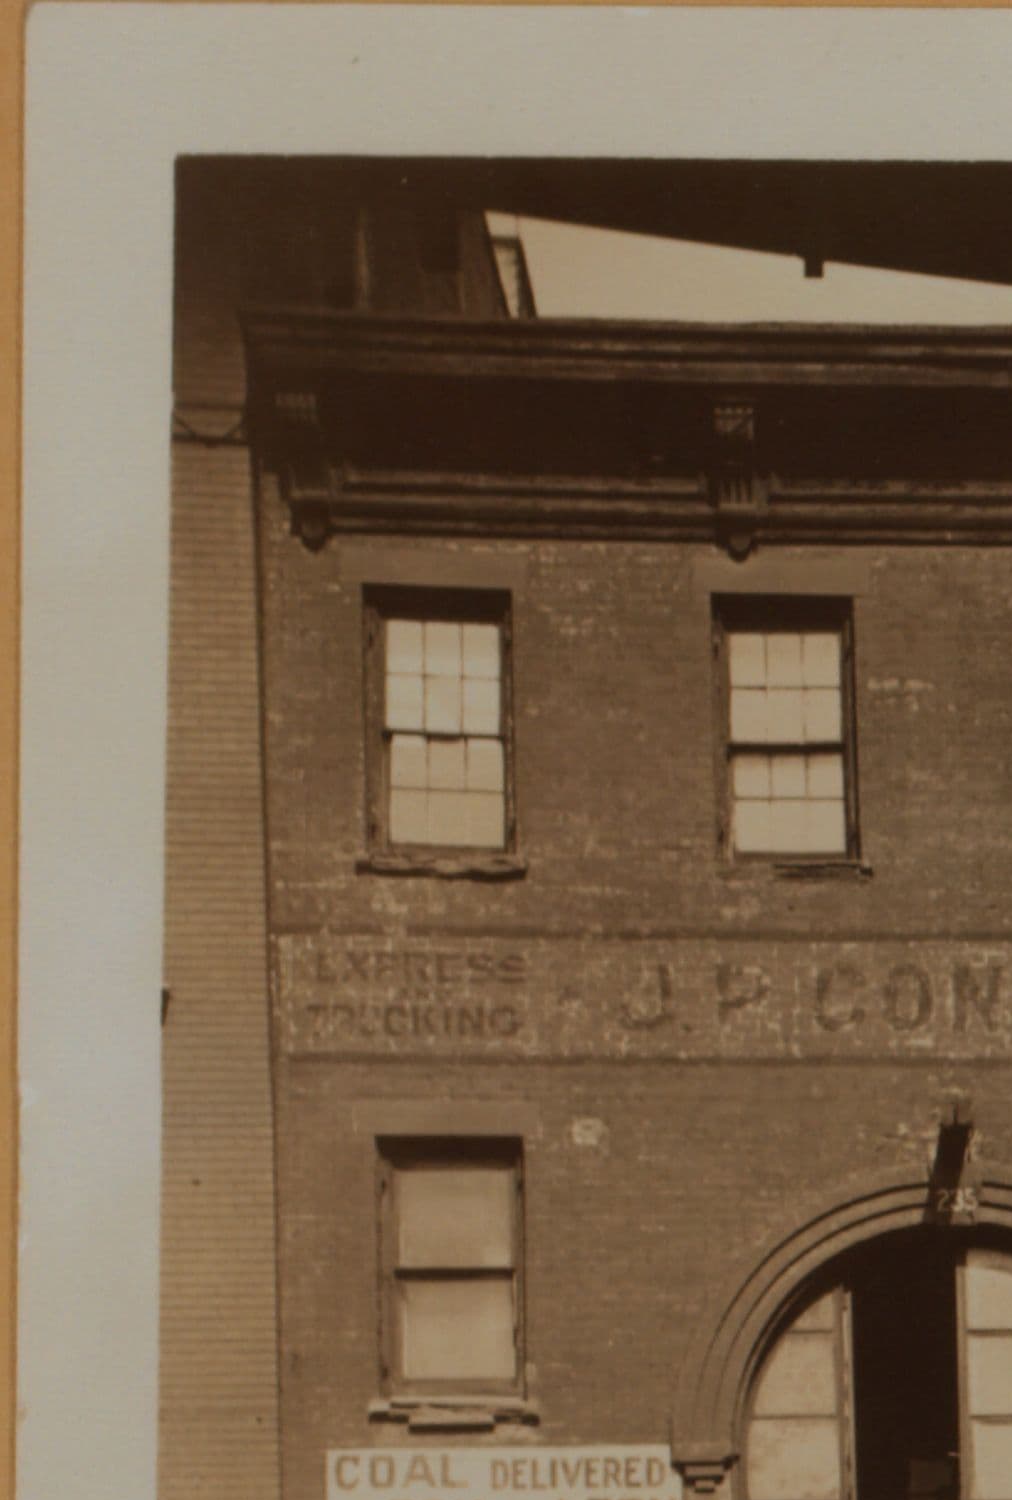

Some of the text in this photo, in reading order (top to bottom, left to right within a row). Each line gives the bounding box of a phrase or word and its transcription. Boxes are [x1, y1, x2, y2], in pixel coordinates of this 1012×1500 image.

[316, 951, 527, 984] EXPRESS
[306, 1004, 524, 1038] TRUCKING
[334, 1454, 667, 1490] COAL DELIVERED
